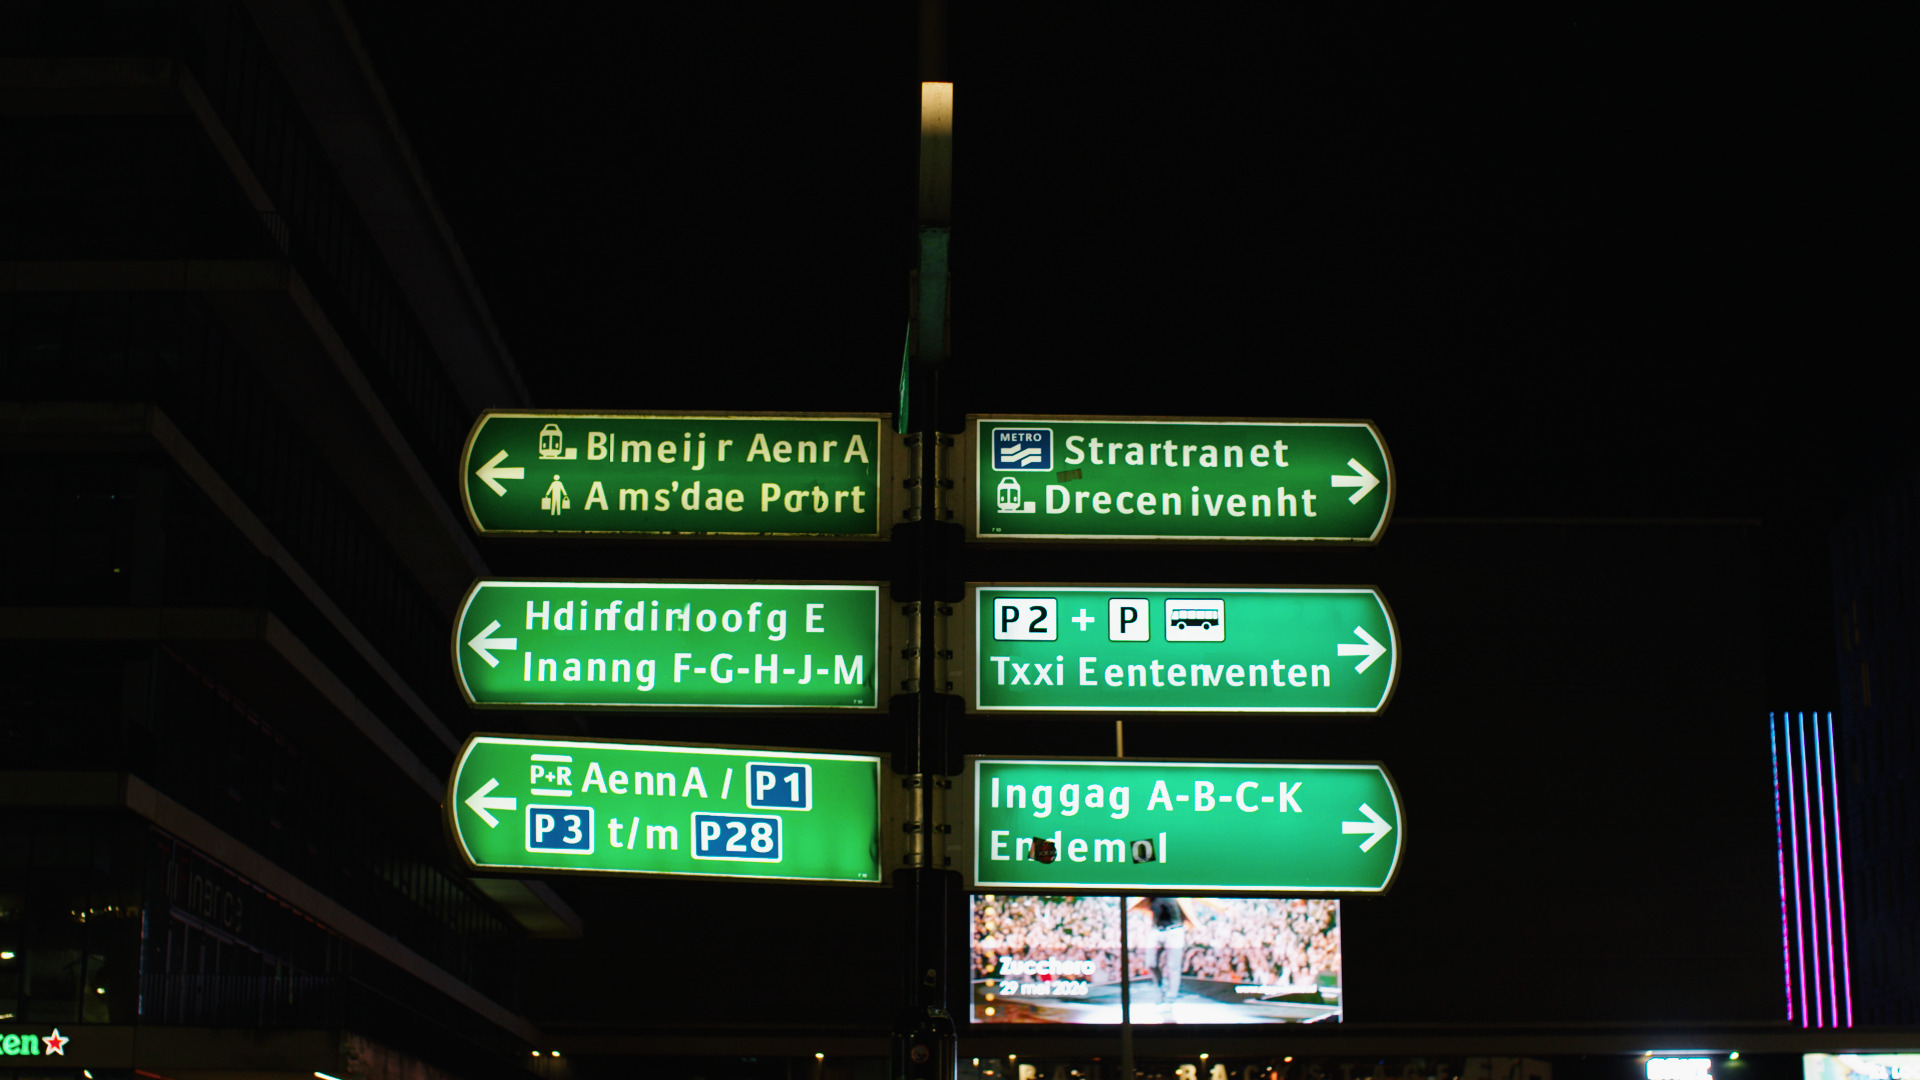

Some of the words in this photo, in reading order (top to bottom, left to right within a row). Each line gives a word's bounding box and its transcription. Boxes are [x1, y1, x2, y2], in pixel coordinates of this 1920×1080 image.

[1000, 432, 1042, 442] METRO
[1065, 436, 1288, 467] Strartranet
[806, 604, 824, 632] E
[1121, 607, 1137, 633] P
[524, 652, 655, 691] Inanng
[674, 653, 862, 684] F-G-H-J-M
[991, 655, 1063, 685] Txxi
[531, 765, 572, 785] P+R
[721, 768, 732, 799] /
[992, 778, 1129, 819] Inggag
[1147, 781, 1302, 812] A-B-C-K
[608, 817, 677, 850] t/m
[701, 822, 773, 853] P28
[999, 956, 1096, 975] Zucchero
[999, 980, 1019, 995] 29
[1052, 980, 1089, 995] 2026
